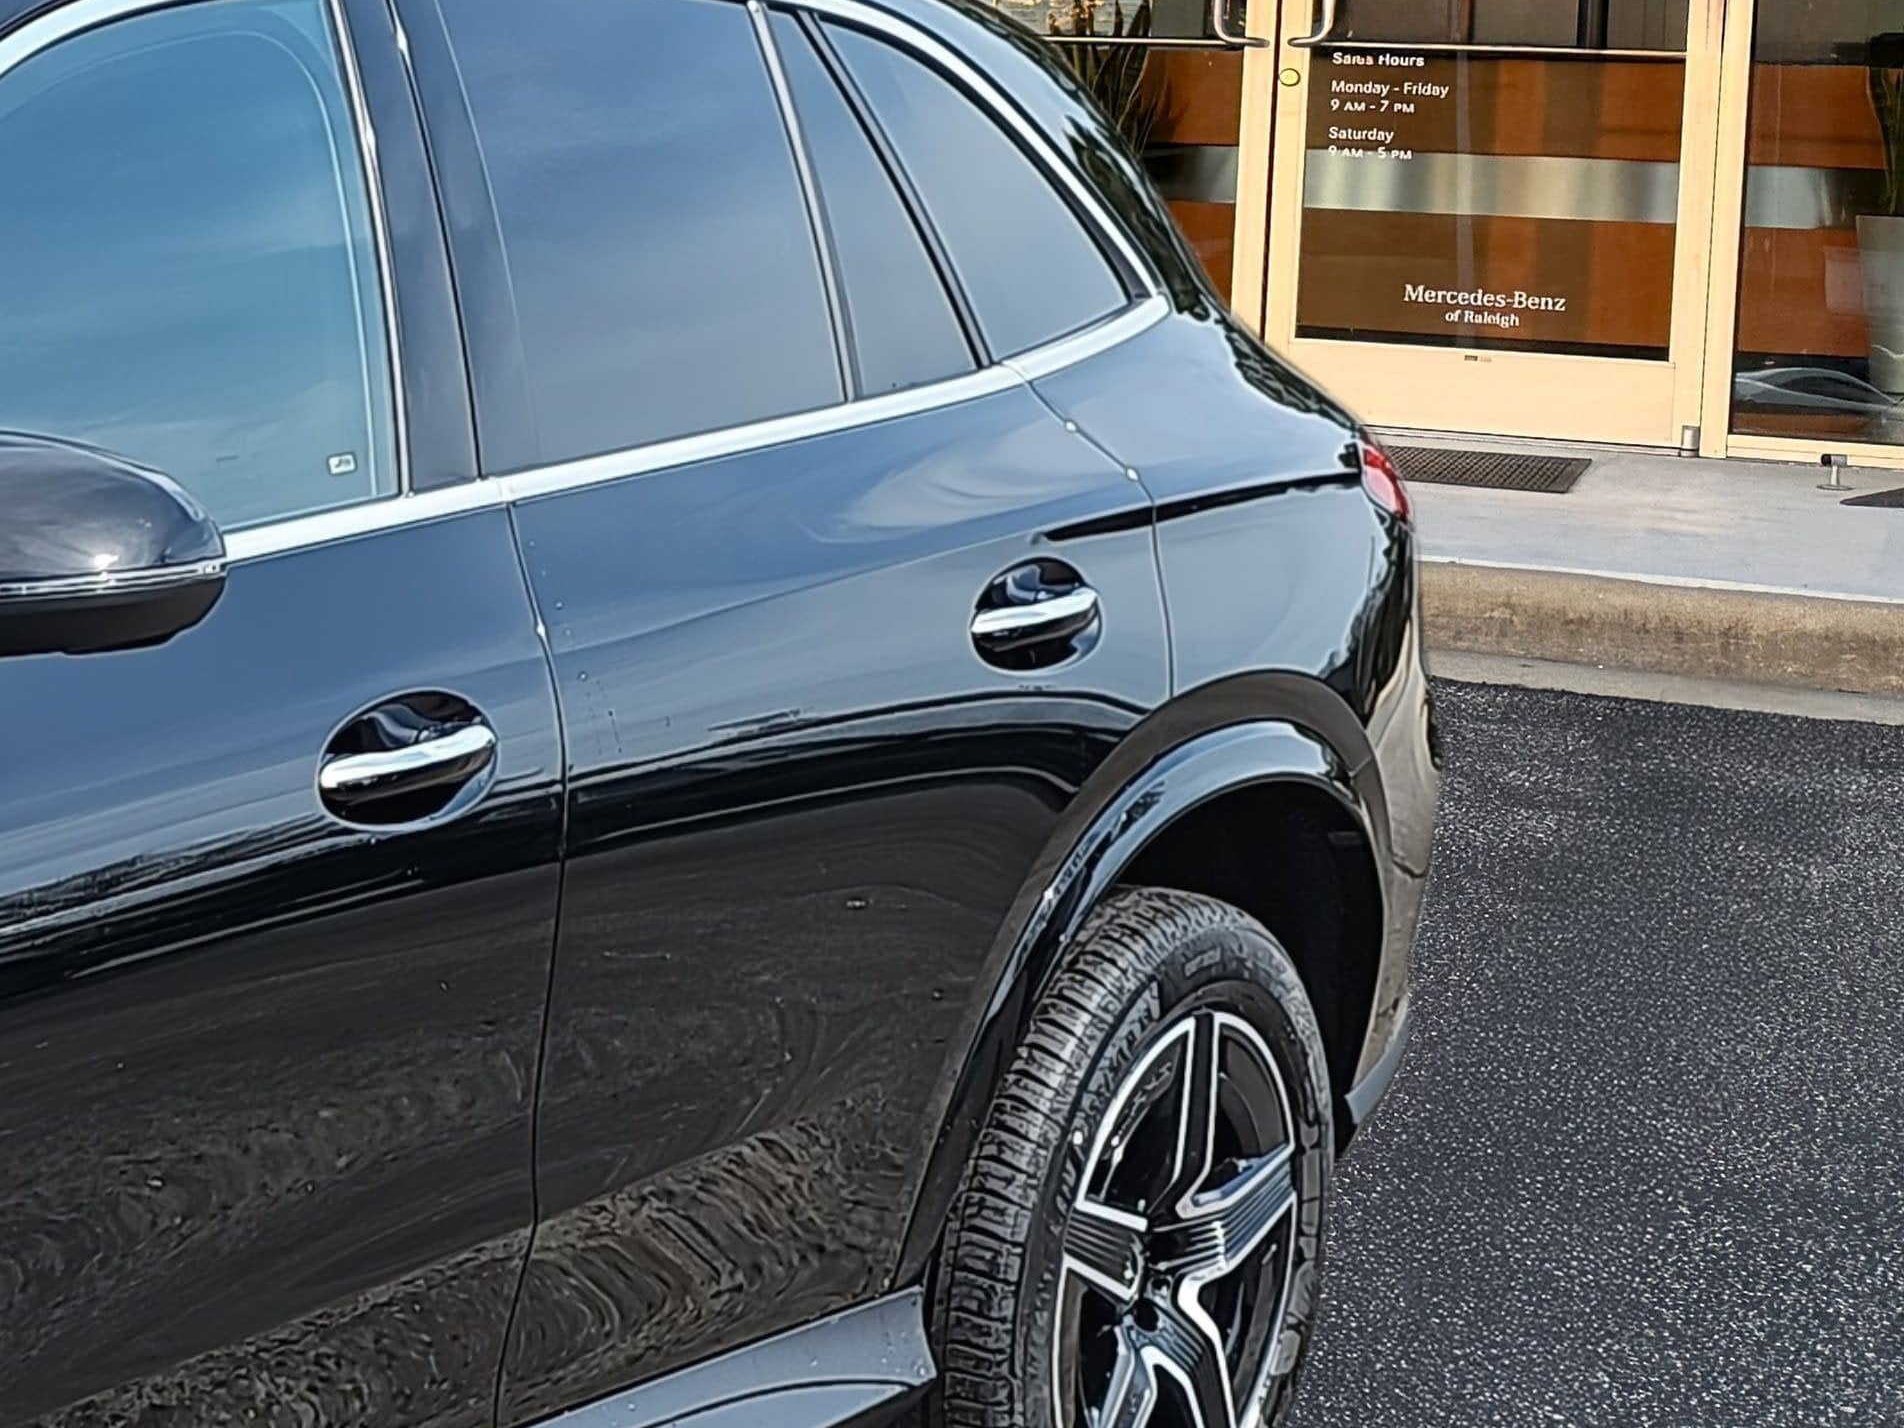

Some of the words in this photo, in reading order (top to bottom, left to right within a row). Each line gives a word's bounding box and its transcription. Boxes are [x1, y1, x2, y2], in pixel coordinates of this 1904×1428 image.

[1378, 53, 1425, 67] Hours
[1331, 80, 1390, 97] Monday
[1403, 82, 1450, 99] Friday
[1330, 99, 1340, 111] 9
[1344, 102, 1366, 111] AM
[1380, 100, 1389, 112] 7
[1394, 103, 1415, 113] PM
[1328, 126, 1394, 144] Saturday
[1328, 145, 1337, 156] 9
[1342, 148, 1364, 158] AM
[1377, 147, 1387, 159] 5
[1391, 149, 1412, 160] PM
[1403, 284, 1567, 311] Mercedes-Benz
[1445, 309, 1461, 322] of
[1464, 310, 1520, 328] Raleigh
